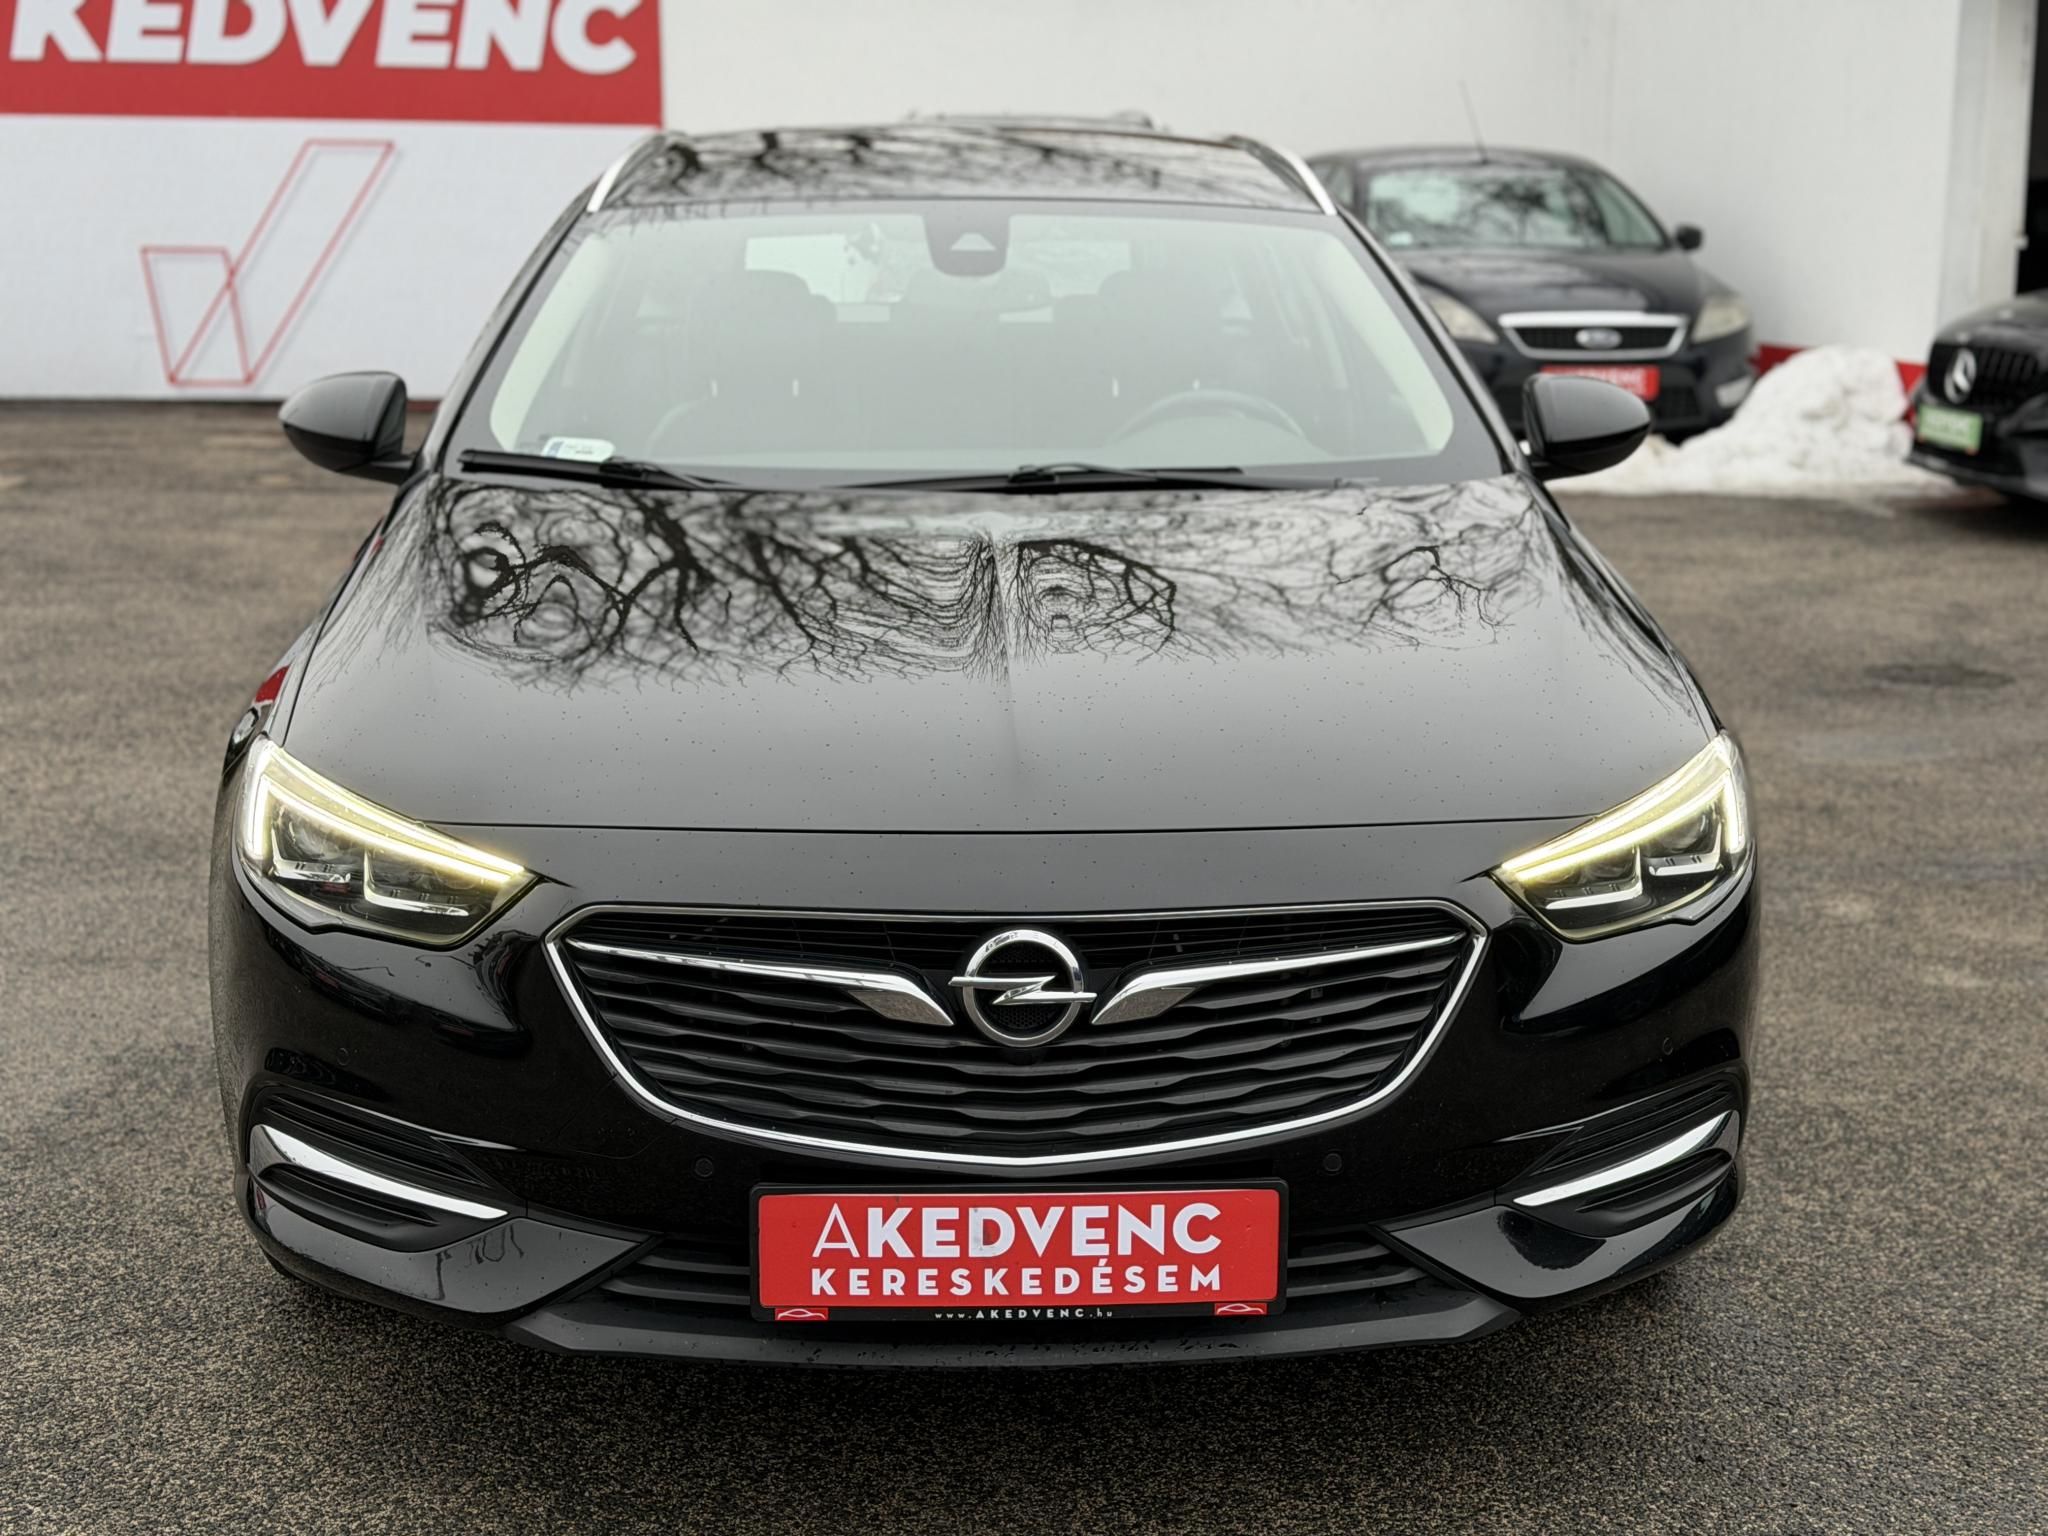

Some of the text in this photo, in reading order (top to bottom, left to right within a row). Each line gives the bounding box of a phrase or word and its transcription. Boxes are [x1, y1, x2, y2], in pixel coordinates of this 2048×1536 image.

[9, 0, 641, 75] KEDVENC
[811, 1259, 1221, 1297] KERESKEDÉSEM
[934, 1308, 1113, 1320] www.AKEDVENC.hu
